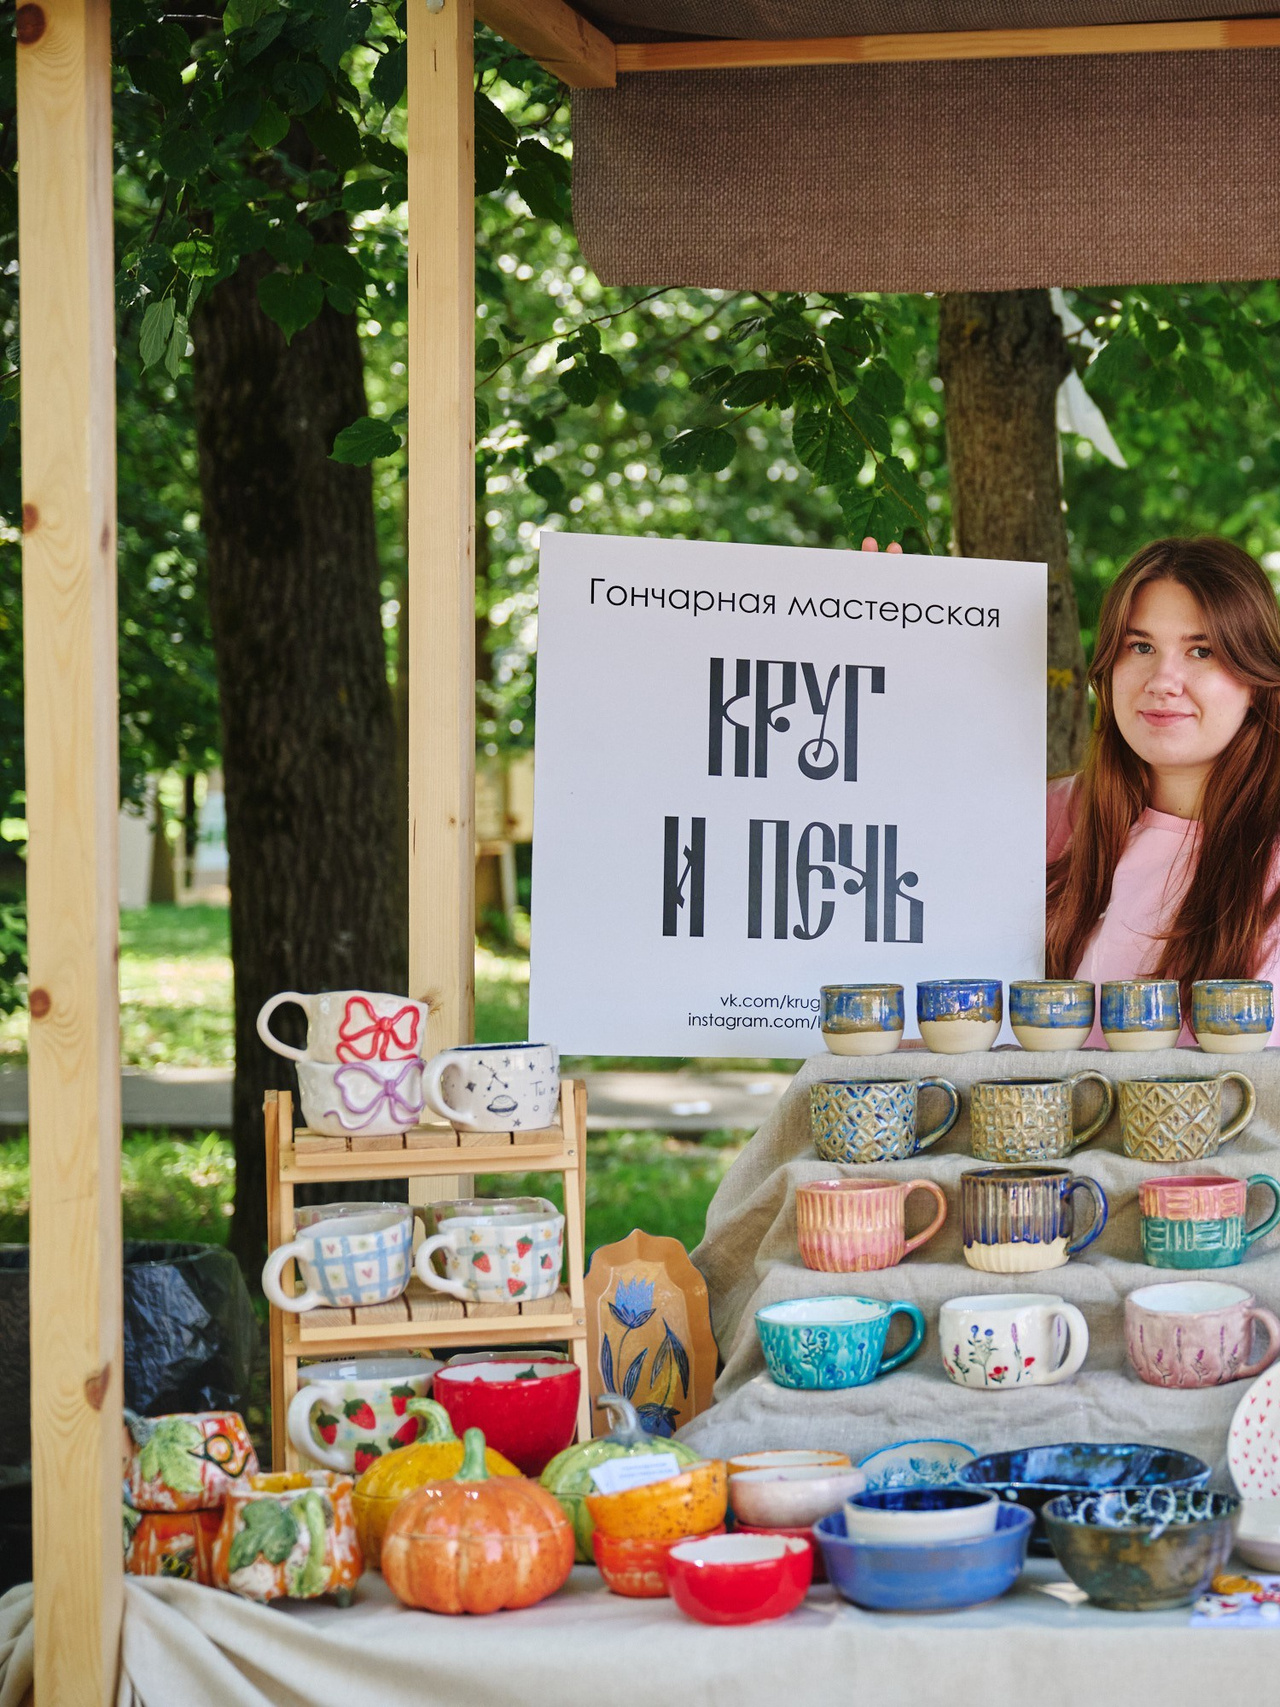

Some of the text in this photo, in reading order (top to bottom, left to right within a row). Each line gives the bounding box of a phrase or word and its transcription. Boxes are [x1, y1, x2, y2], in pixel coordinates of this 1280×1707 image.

[589, 577, 1001, 629] Гончарная мастерская
[707, 656, 886, 783] КРУГ
[661, 815, 925, 944] И ПЕЧЬ
